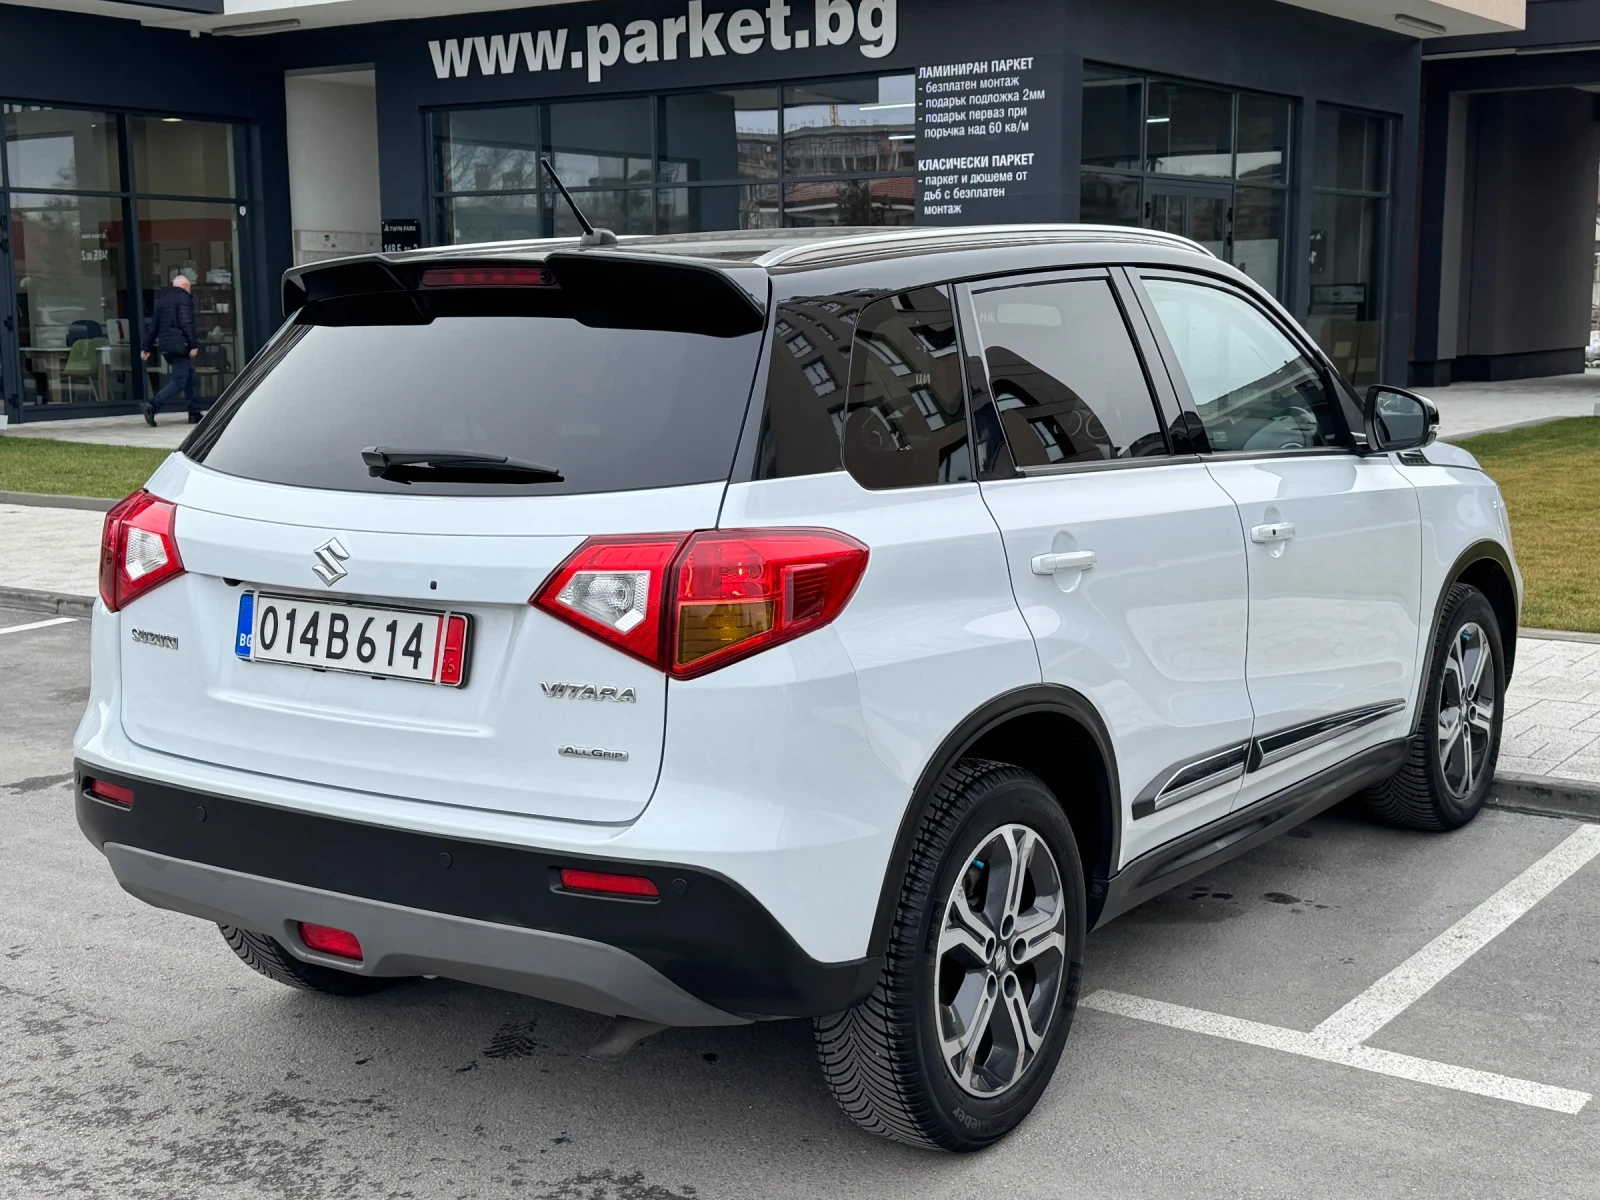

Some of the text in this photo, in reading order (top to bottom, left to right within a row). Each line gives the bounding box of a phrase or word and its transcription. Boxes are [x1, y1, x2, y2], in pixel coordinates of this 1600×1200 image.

[428, 0, 898, 82] www.parket.bg
[918, 57, 1034, 78] ЛАМИНИРАН ПАРКЕТ
[925, 80, 977, 93] безплатен
[980, 76, 1020, 89] монтаж
[925, 96, 967, 109] подарък
[969, 91, 1020, 105] подложка
[1022, 88, 1045, 101] 2мм
[925, 111, 967, 124] подарък
[969, 108, 1004, 121] перваз
[1007, 107, 1027, 119] при
[924, 119, 1029, 140] поръчка над 60 кв/м
[918, 153, 1034, 171] КЛАСИЧЕСКИ ПАРКЕТ
[925, 174, 959, 187] паркет
[961, 174, 968, 184] и
[969, 171, 1013, 184] дюшеме
[1015, 171, 1028, 181] от
[923, 187, 1005, 202] дъб с безплатен
[924, 204, 962, 215] монтаж
[259, 605, 424, 671] 014B614
[539, 680, 637, 704] VITARA
